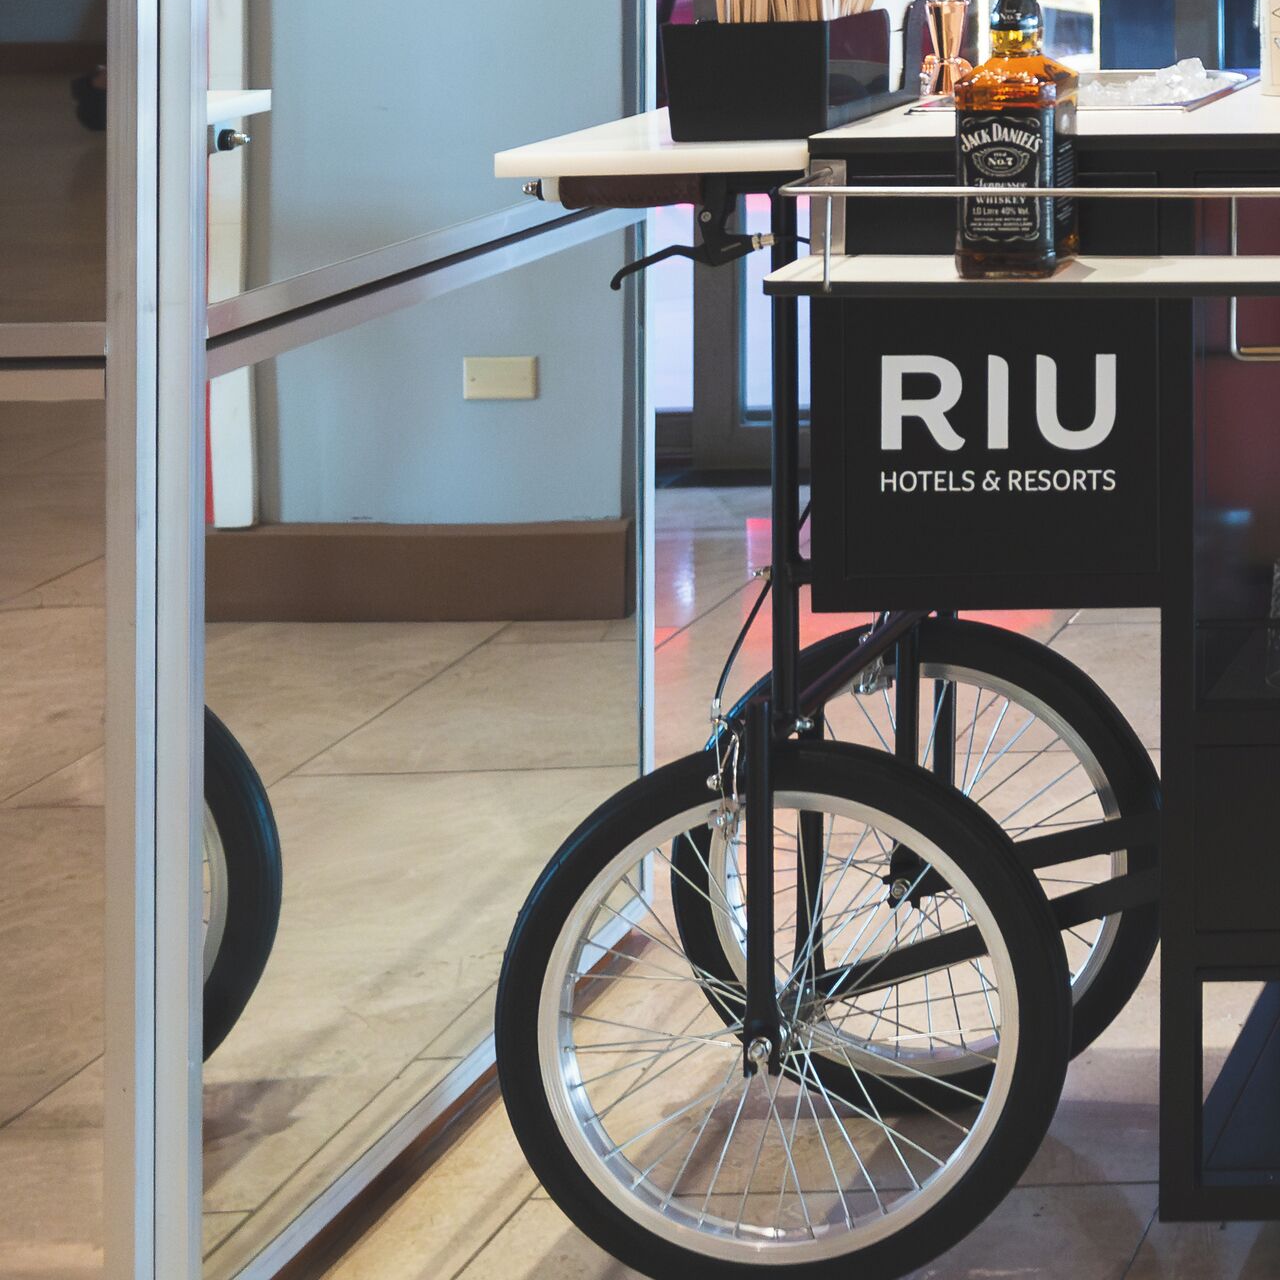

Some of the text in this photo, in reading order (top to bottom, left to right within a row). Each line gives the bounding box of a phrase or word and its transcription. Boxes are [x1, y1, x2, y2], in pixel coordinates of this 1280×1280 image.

[961, 123, 1043, 153] JACK DANIEL'S
[881, 354, 1116, 451] RIU
[880, 470, 1117, 492] HOTELS & RESORTS
